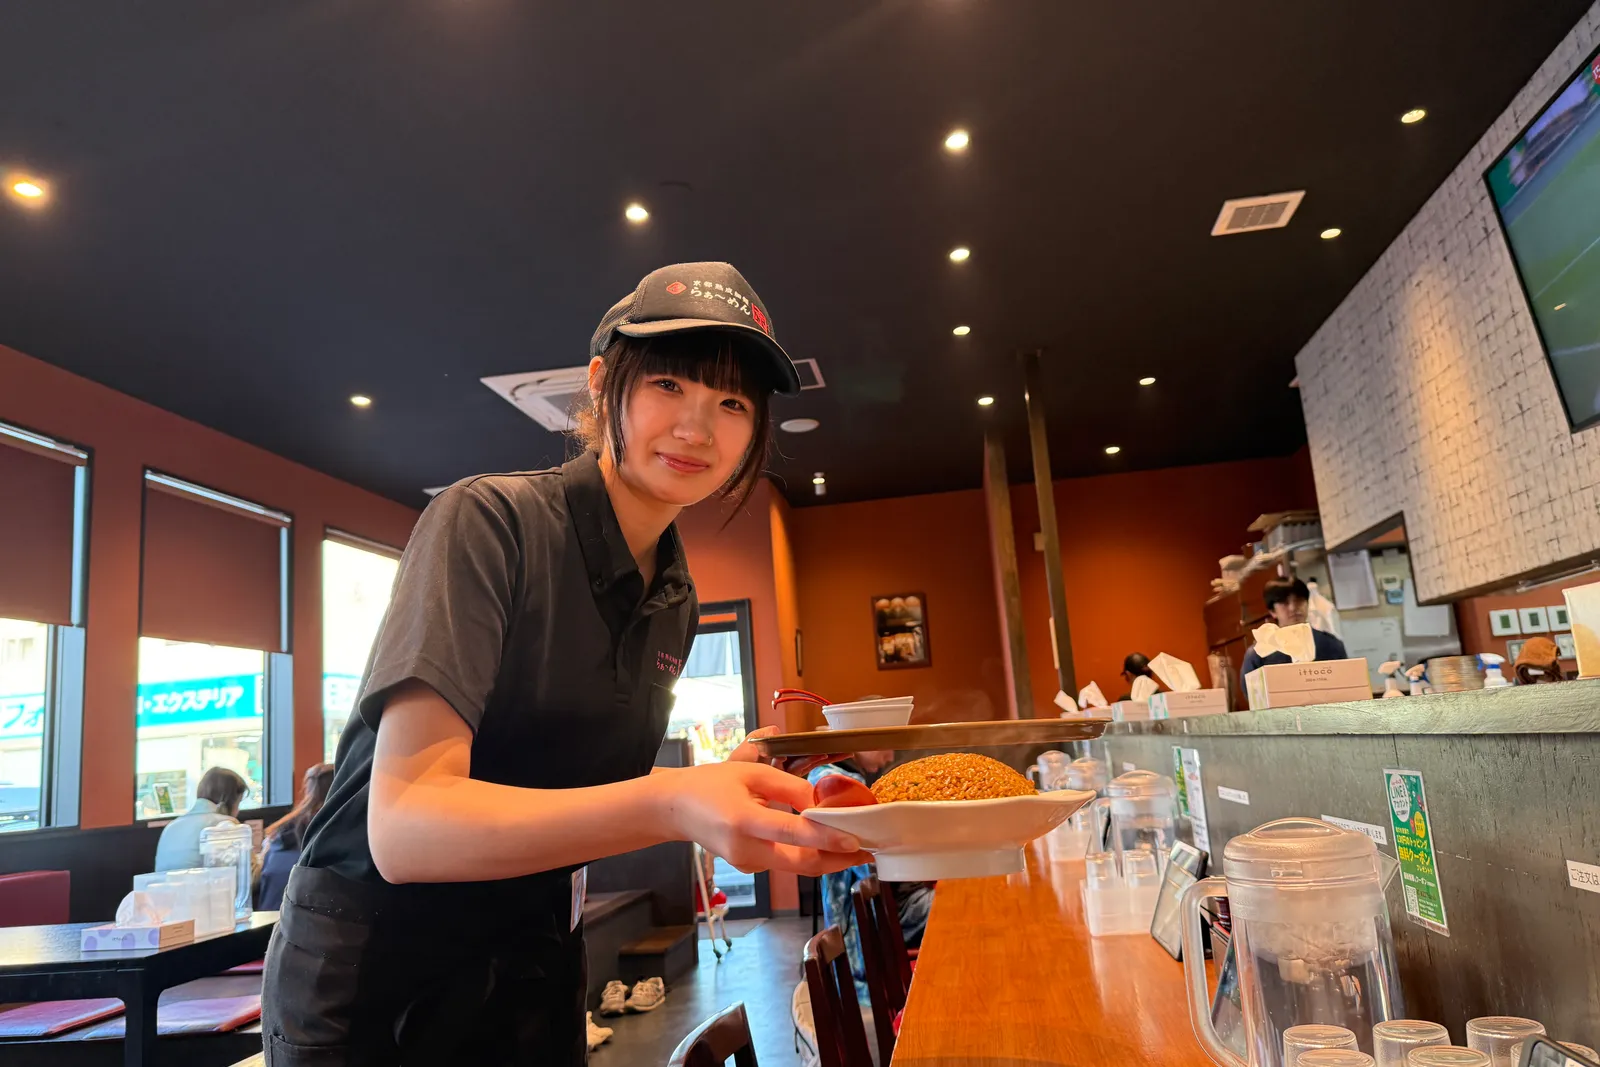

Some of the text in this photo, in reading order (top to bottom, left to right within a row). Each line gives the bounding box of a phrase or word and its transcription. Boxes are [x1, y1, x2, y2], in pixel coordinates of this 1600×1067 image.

[137, 686, 244, 715] ・エクステリア
